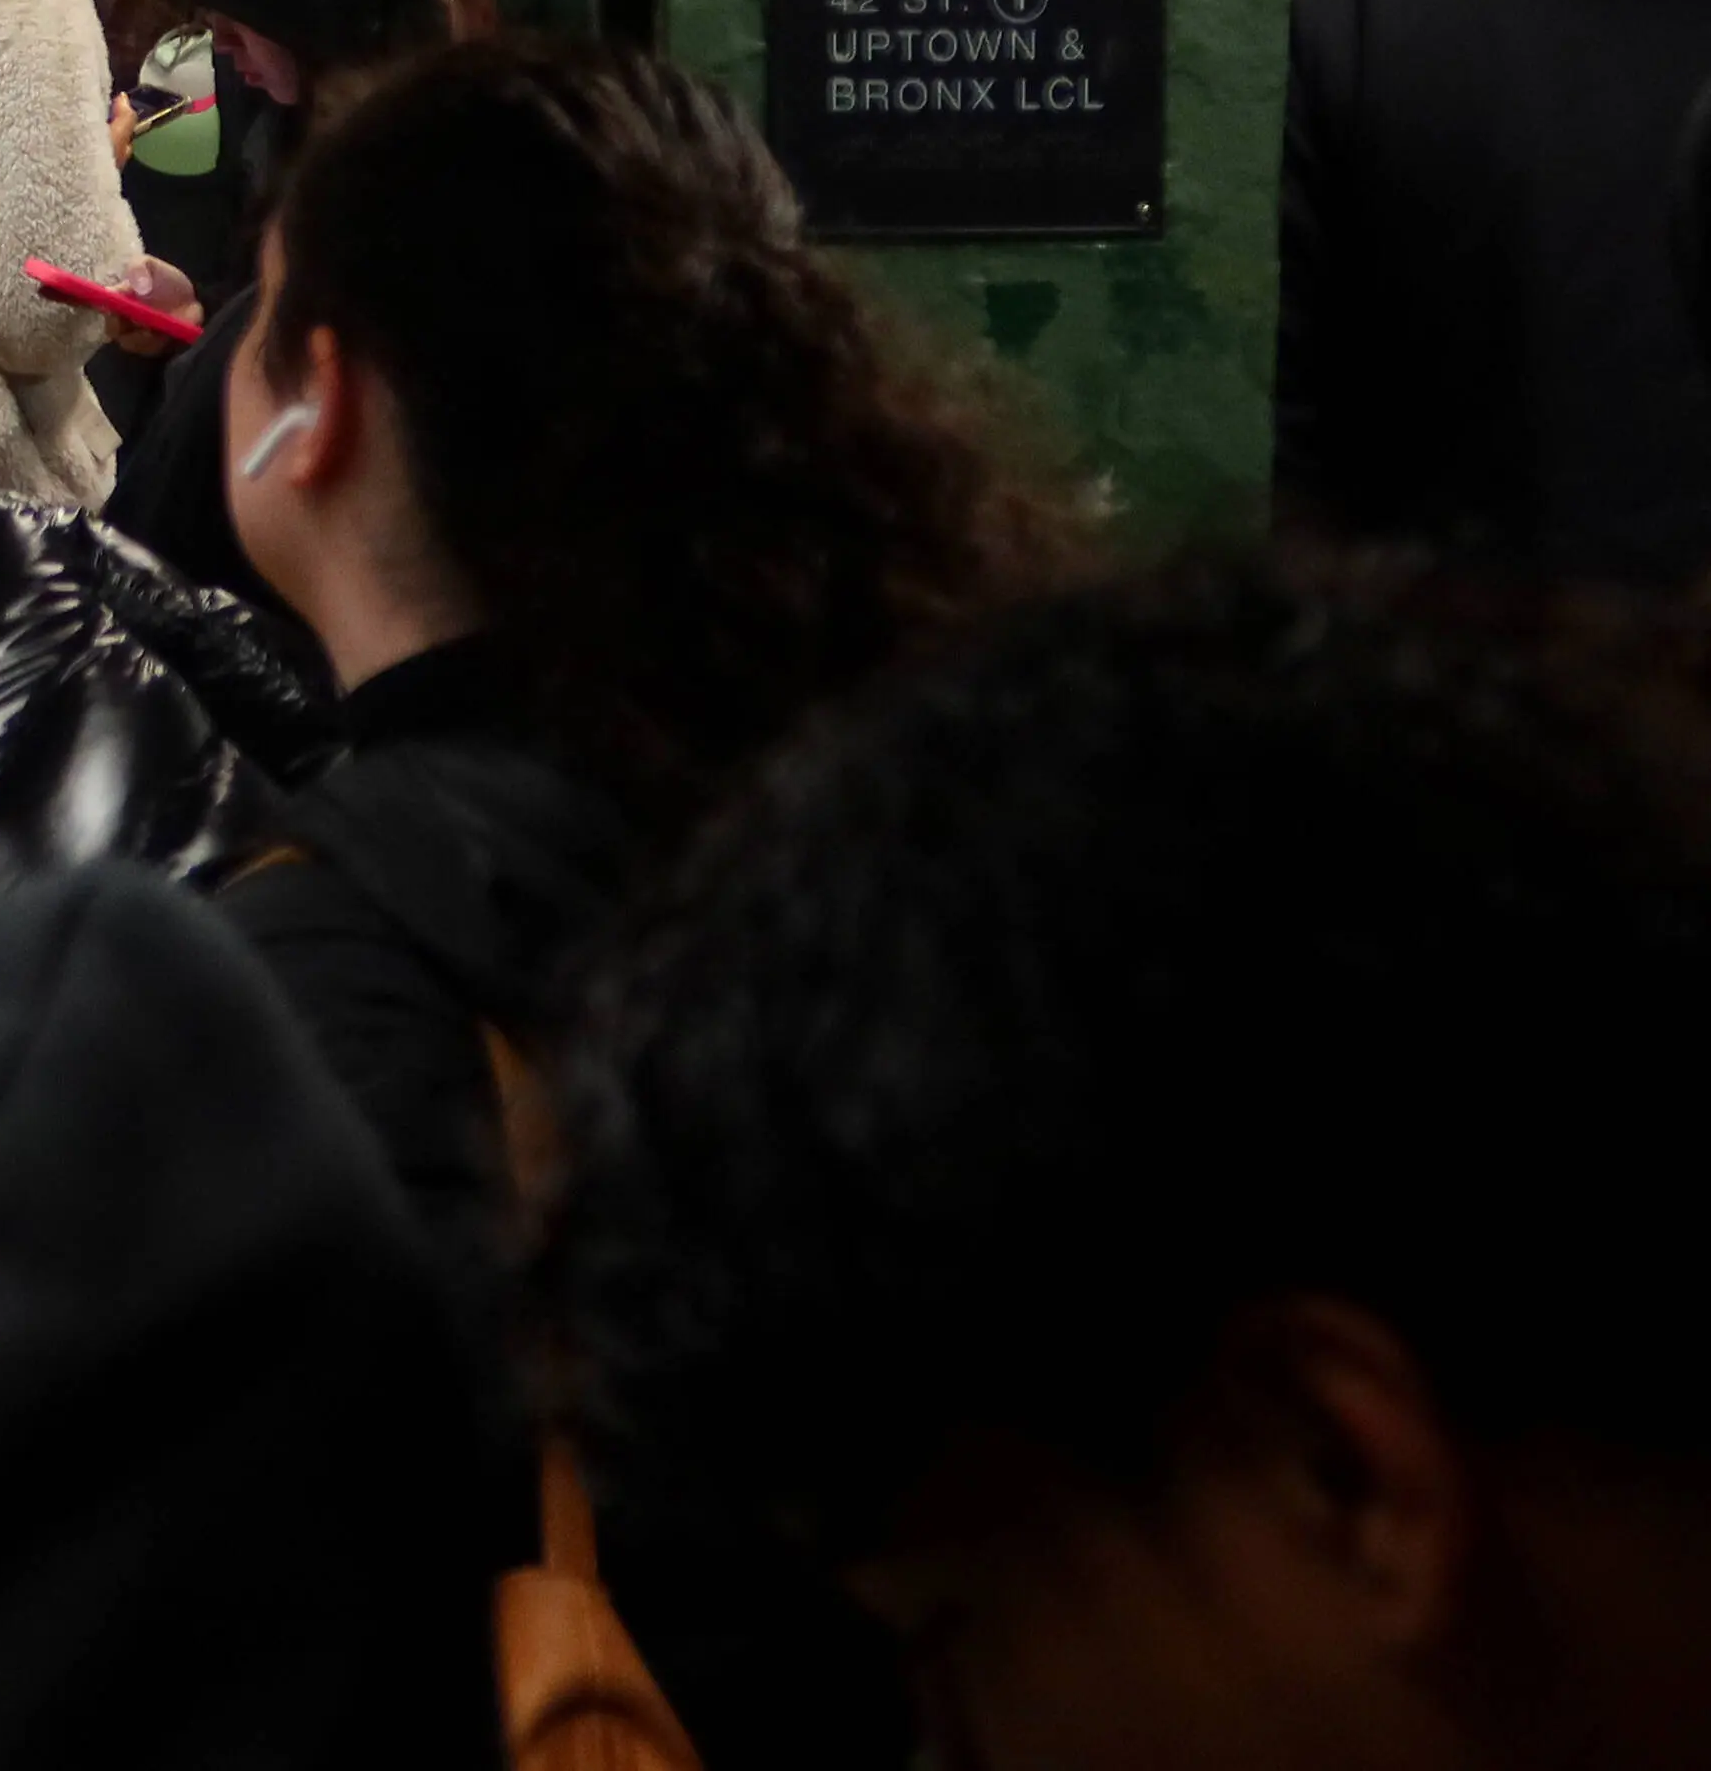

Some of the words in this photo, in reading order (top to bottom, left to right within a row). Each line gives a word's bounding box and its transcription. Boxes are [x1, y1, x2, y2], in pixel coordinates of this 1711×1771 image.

[831, 29, 1037, 63] UPTOWN
[1061, 29, 1085, 61] &
[831, 77, 996, 111] BRONX
[1018, 76, 1105, 111] LCL
